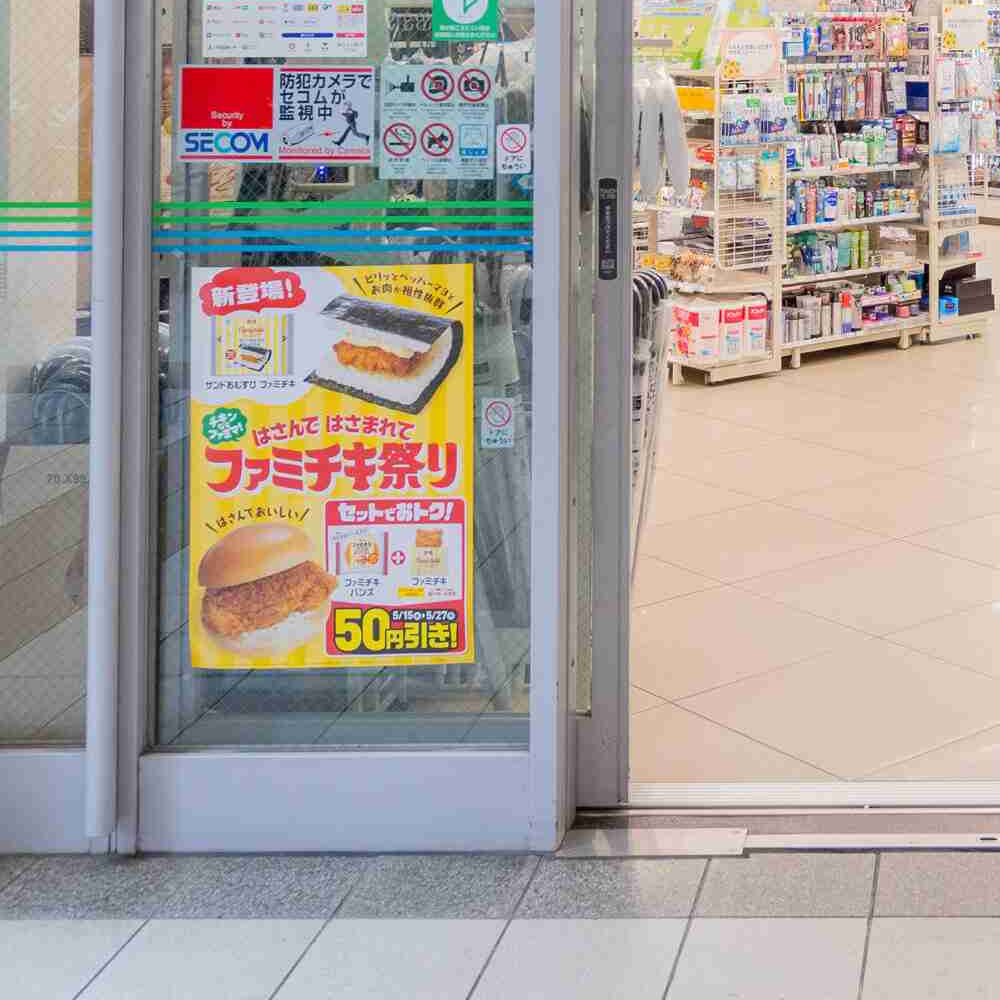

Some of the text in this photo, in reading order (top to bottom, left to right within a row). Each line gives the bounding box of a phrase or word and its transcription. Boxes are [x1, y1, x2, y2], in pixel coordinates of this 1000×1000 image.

[279, 72, 371, 89] 防犯カメラで
[279, 89, 346, 105] セコムが
[210, 111, 245, 121] Security
[279, 105, 333, 121] 監視中
[221, 119, 233, 129] by
[185, 132, 269, 153] SECOM
[260, 379, 297, 389] ファミチキ
[252, 414, 416, 447] はさんで はさまれて
[205, 442, 458, 493] ファミチキ祭り
[216, 507, 300, 529] はさんでおいしい
[338, 502, 455, 522] セットでおトク!
[345, 577, 381, 588] ファミチキ
[411, 577, 449, 586] ファミチキ
[349, 587, 375, 597] バンズ
